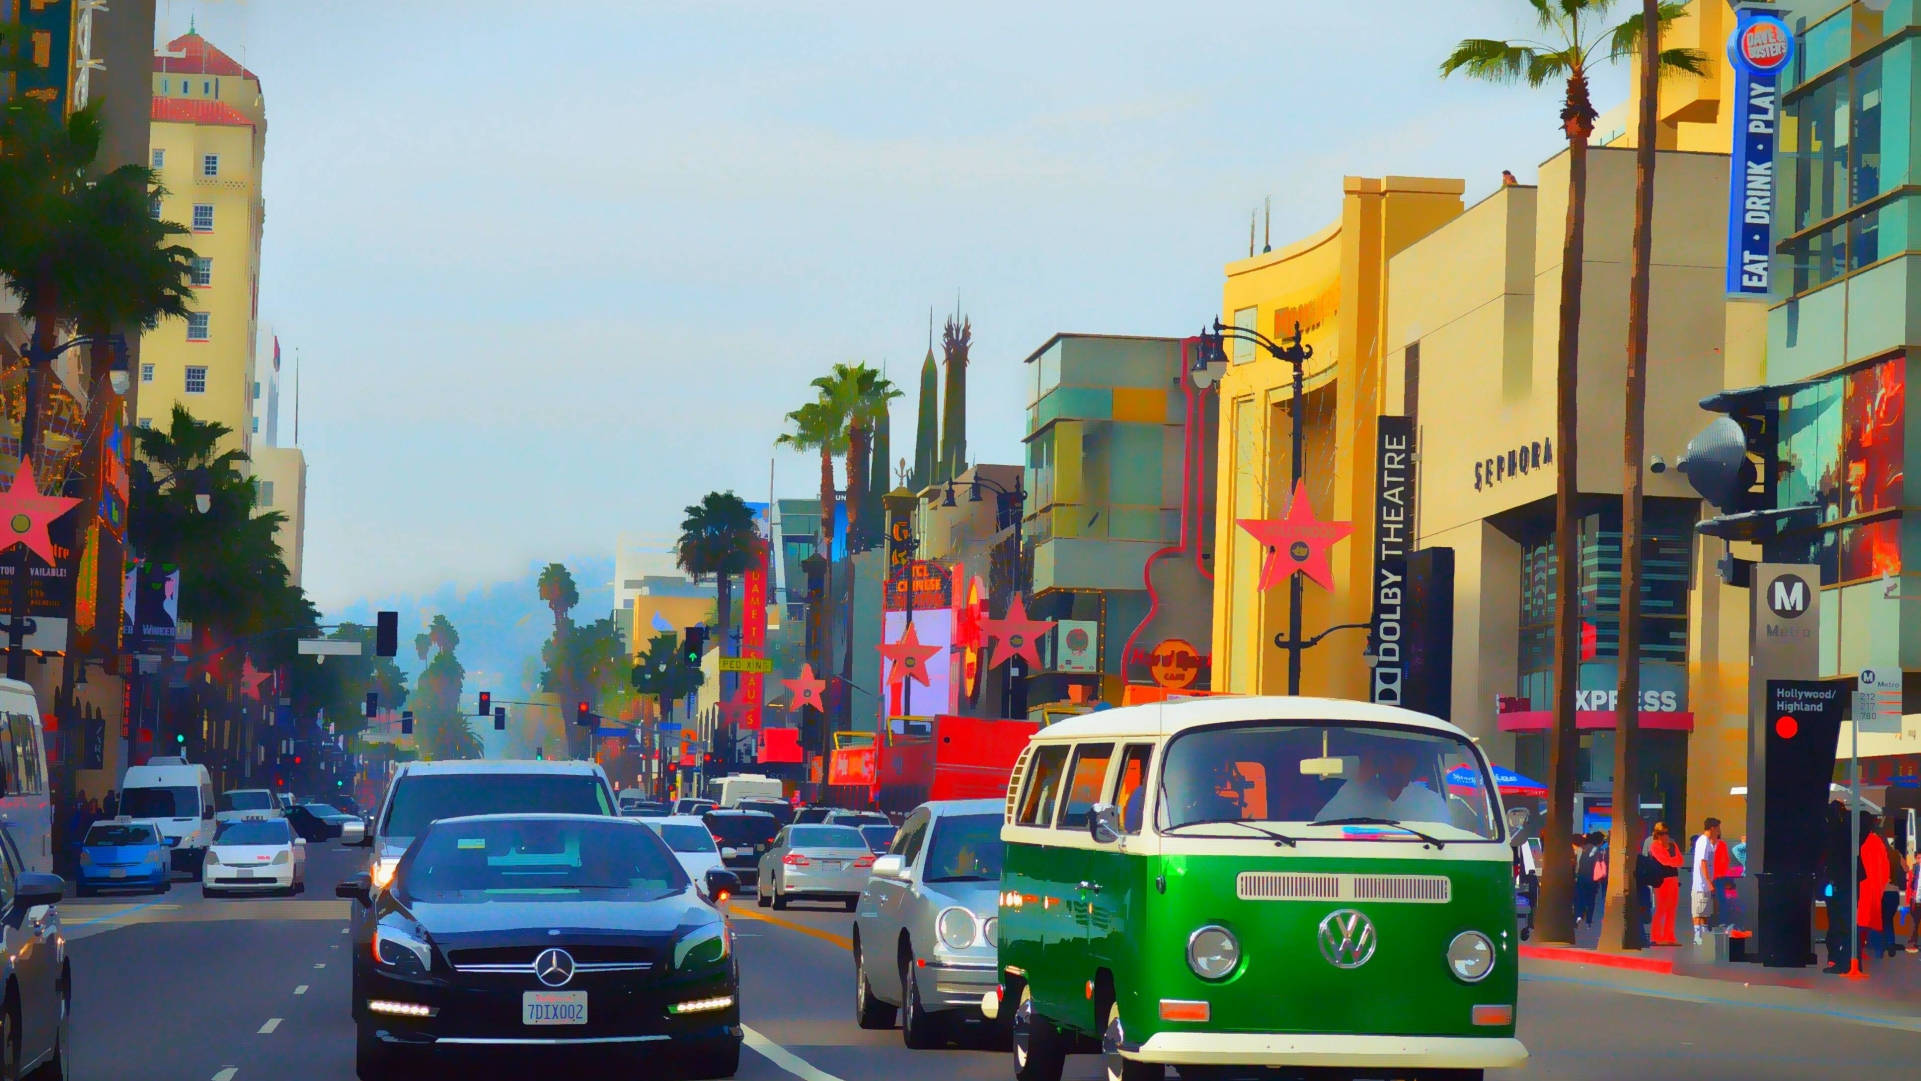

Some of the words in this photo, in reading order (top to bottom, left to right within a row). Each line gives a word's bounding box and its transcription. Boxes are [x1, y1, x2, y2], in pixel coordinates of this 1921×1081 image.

[1748, 82, 1775, 134] PLAY
[1745, 160, 1773, 225] DRINK
[1742, 250, 1769, 288] EAT
[1474, 436, 1553, 493] SEPHORA
[1381, 434, 1406, 561] THEATRE
[1379, 568, 1402, 662] DOLBY
[1774, 581, 1804, 611] M
[1776, 687, 1837, 700] Hollywood/
[1877, 681, 1900, 689] Metro
[1776, 700, 1823, 713] Highland
[527, 1003, 584, 1020] 7DIX002
